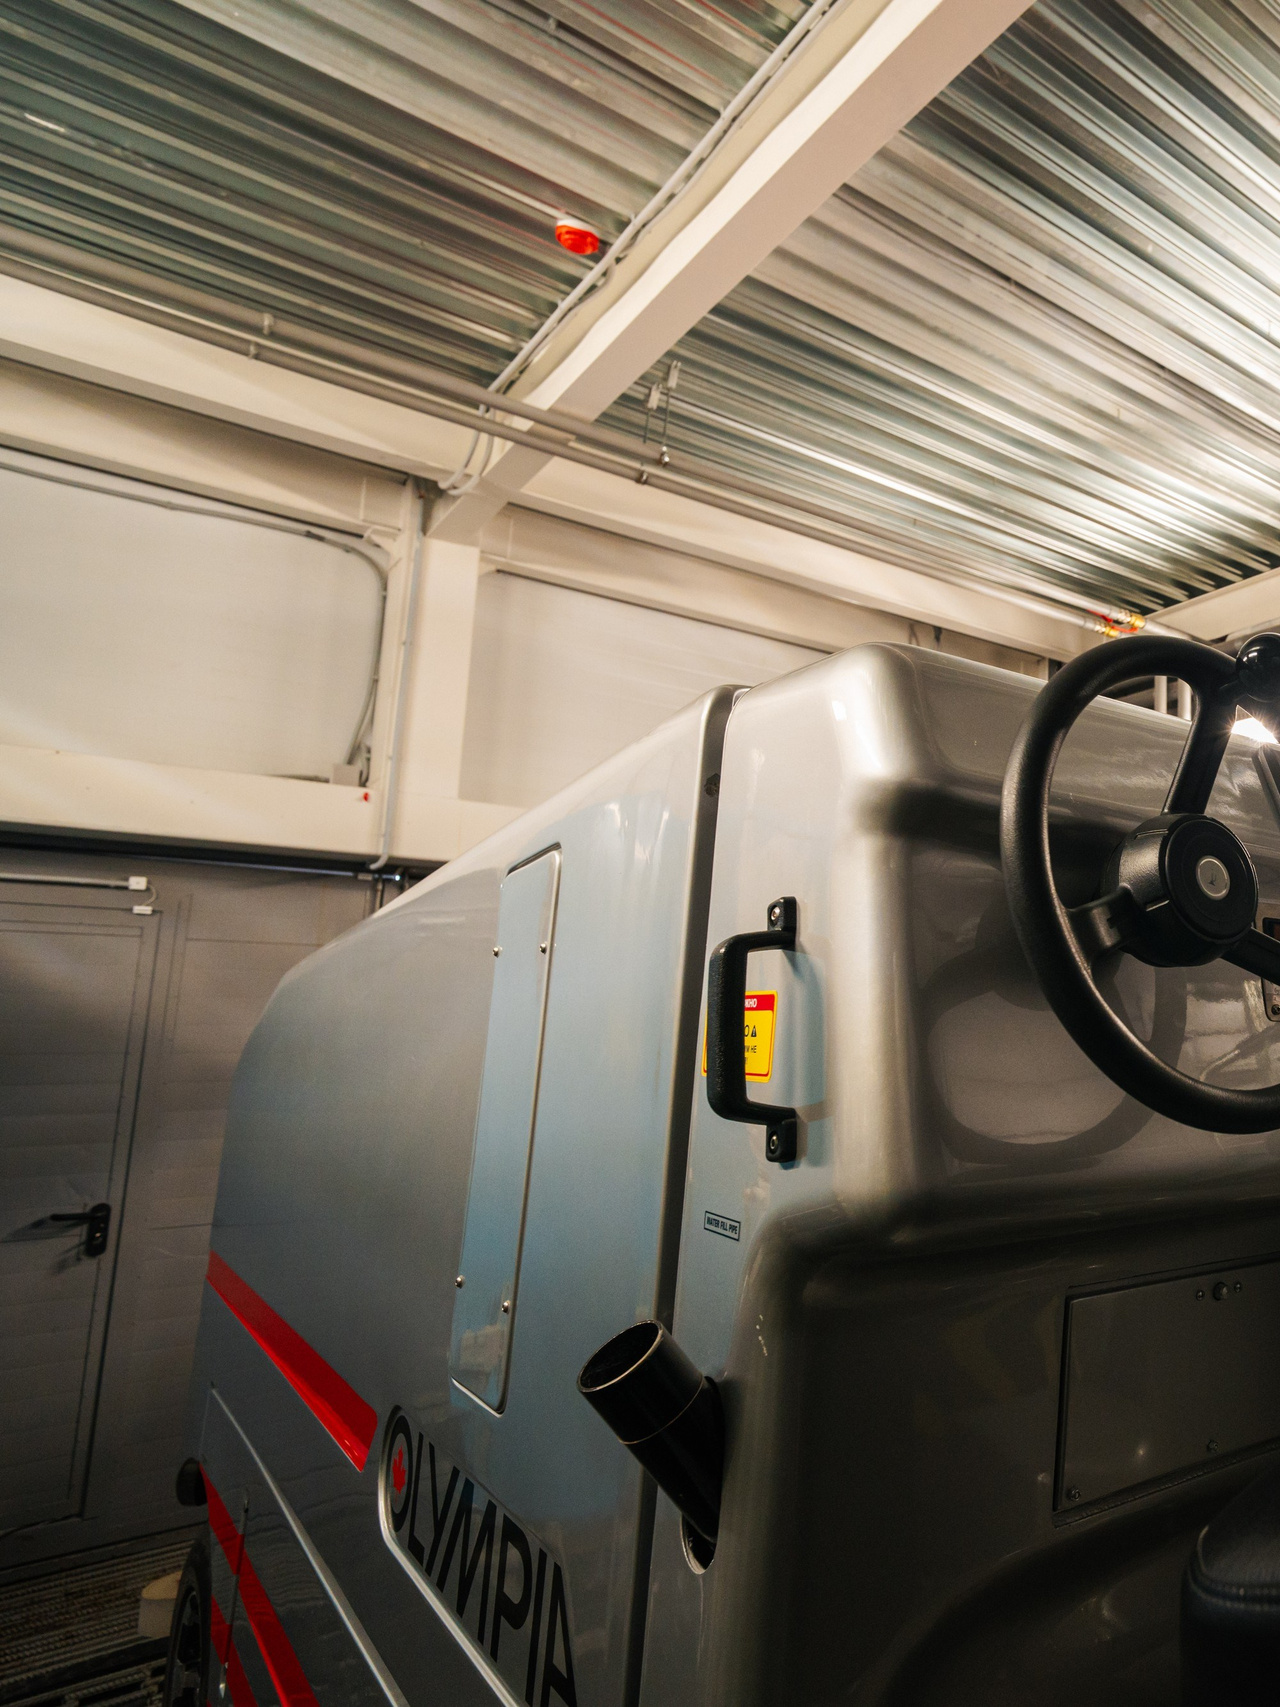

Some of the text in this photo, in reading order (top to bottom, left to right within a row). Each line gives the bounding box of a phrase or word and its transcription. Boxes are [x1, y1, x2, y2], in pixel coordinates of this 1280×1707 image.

[707, 1216, 738, 1235] WATER FILL PIPE
[386, 1414, 577, 1707] OLYMPIA
